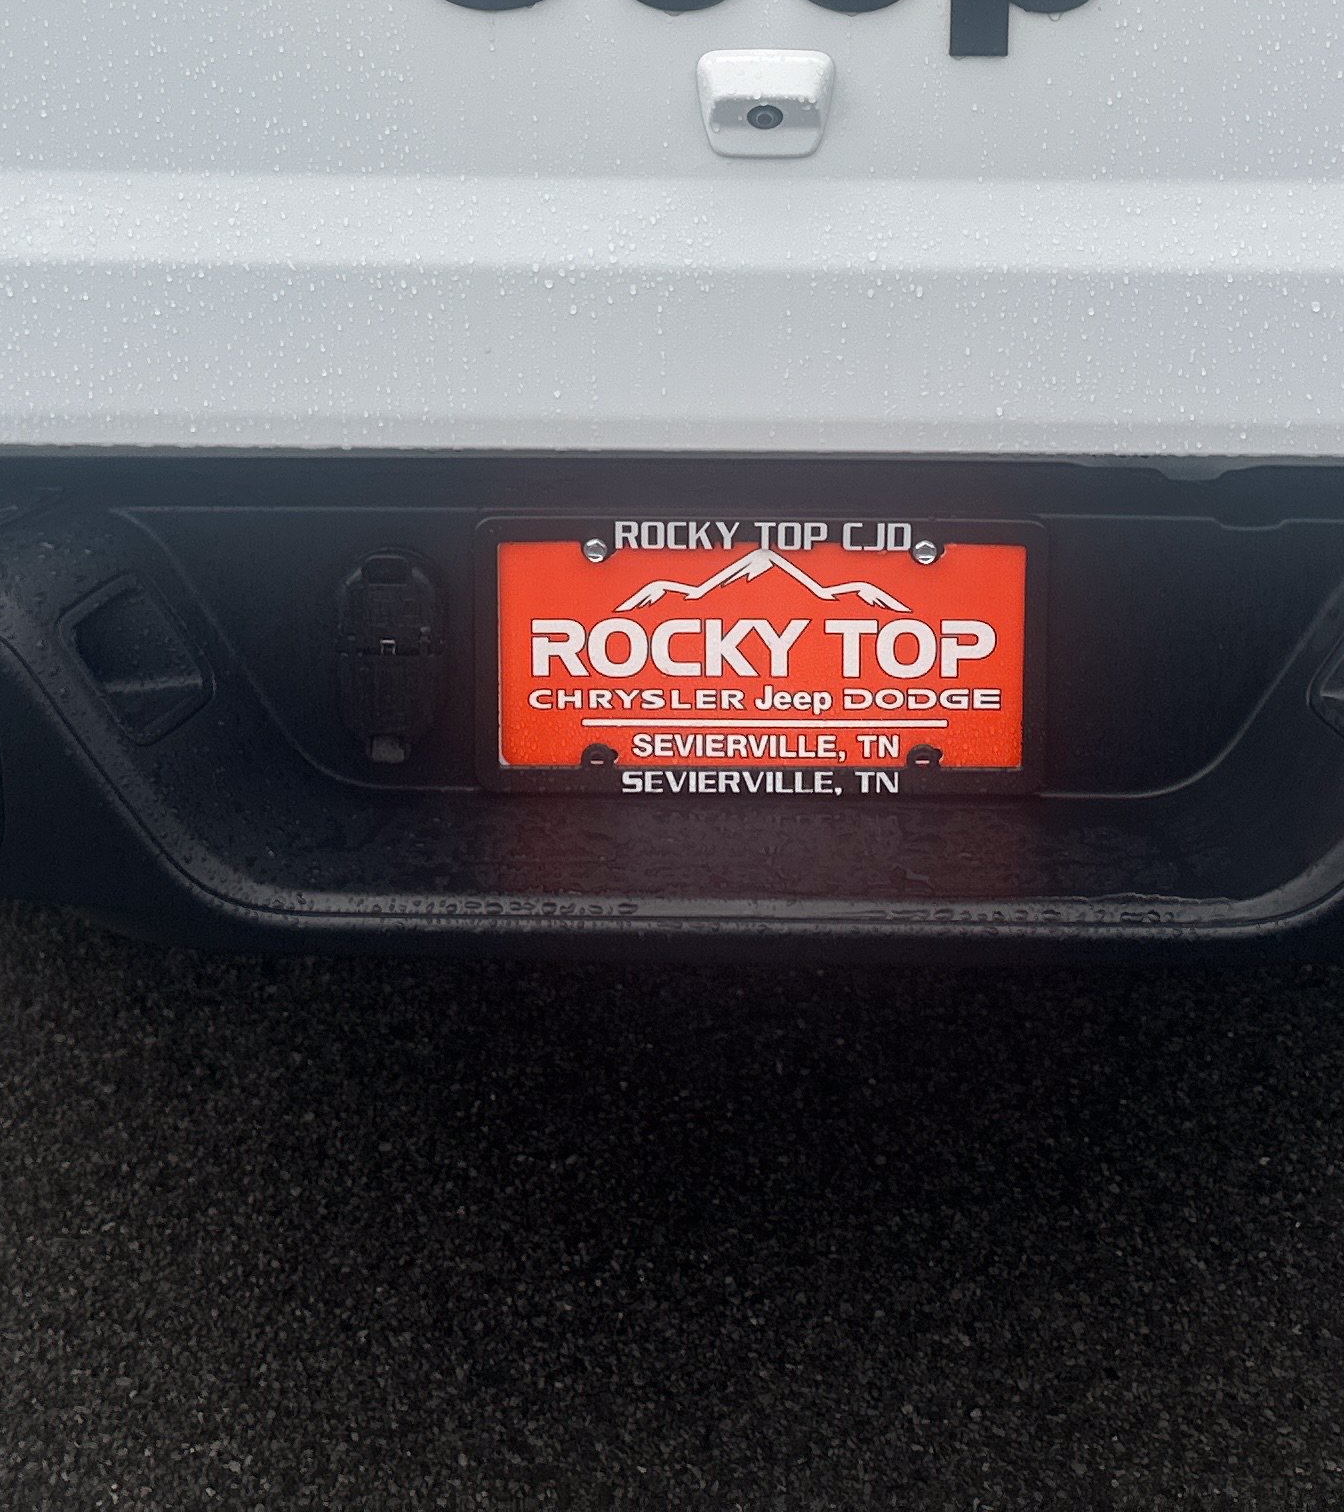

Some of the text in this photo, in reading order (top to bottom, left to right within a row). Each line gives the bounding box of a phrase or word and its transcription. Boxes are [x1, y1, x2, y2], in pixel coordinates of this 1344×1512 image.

[614, 521, 912, 551] ROCKY TOP CJD
[530, 618, 997, 678] ROCKY TOP
[528, 686, 1001, 714] CHRYSLER Jeep DODGE
[631, 735, 900, 762] SEVIERVILLE, TN
[621, 771, 899, 796] SEVIERVILLE, TN
